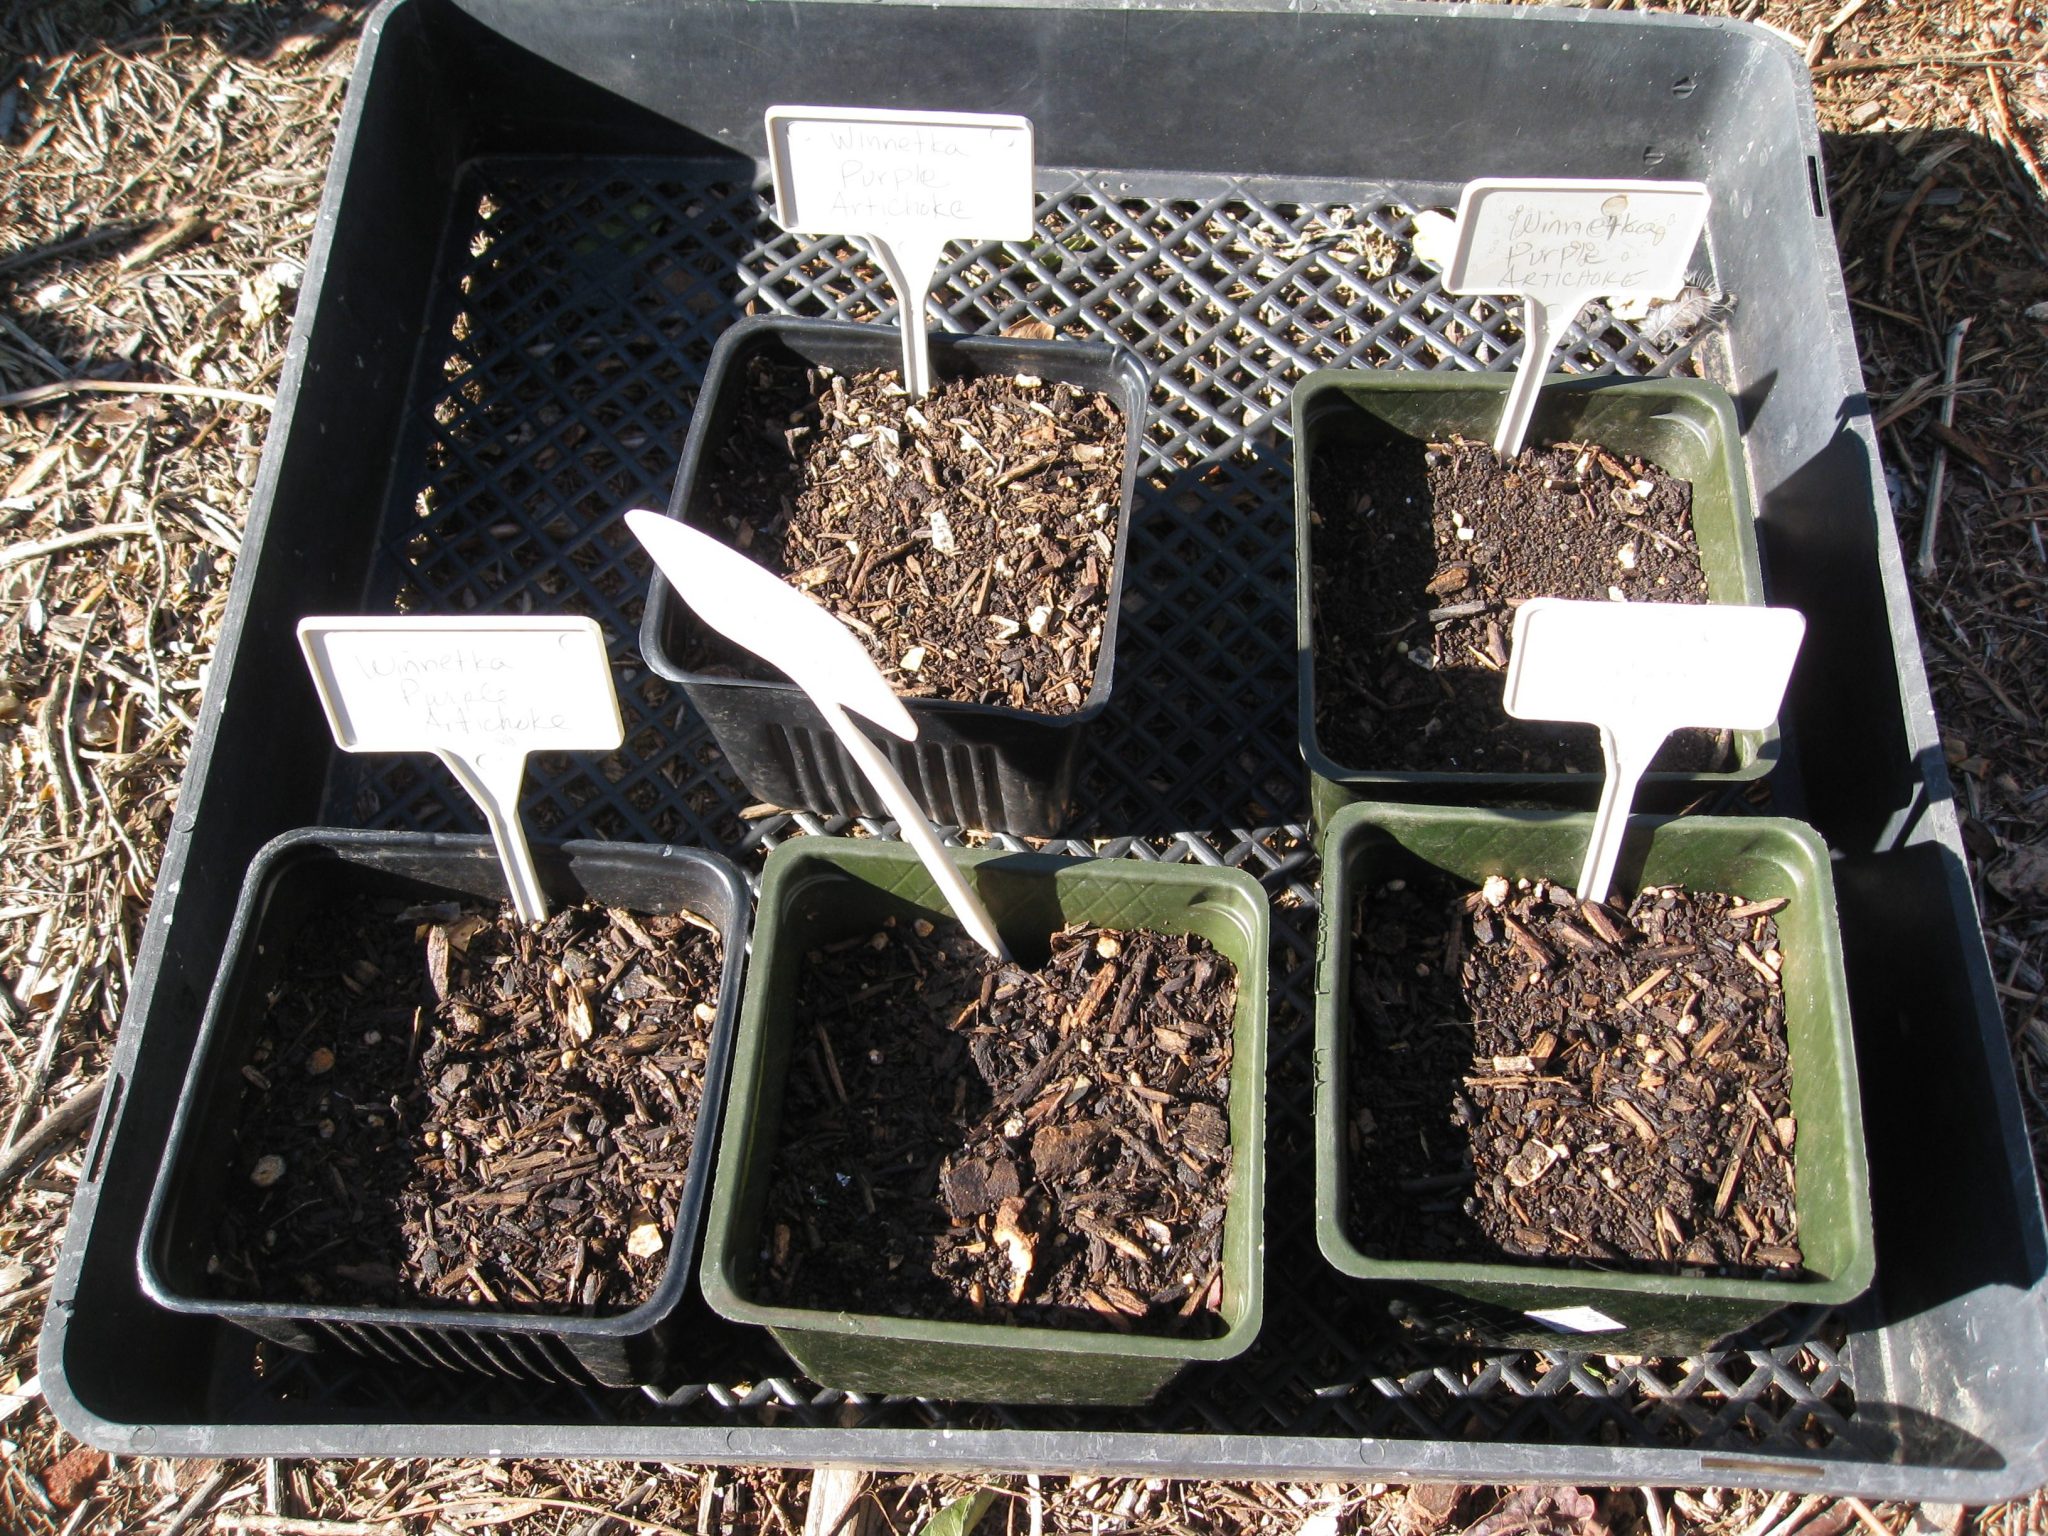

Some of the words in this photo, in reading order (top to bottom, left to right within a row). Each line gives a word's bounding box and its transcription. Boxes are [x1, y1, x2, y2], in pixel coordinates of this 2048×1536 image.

[841, 159, 950, 190] Purple
[831, 191, 973, 220] Artichoke
[1507, 241, 1607, 269] Purple
